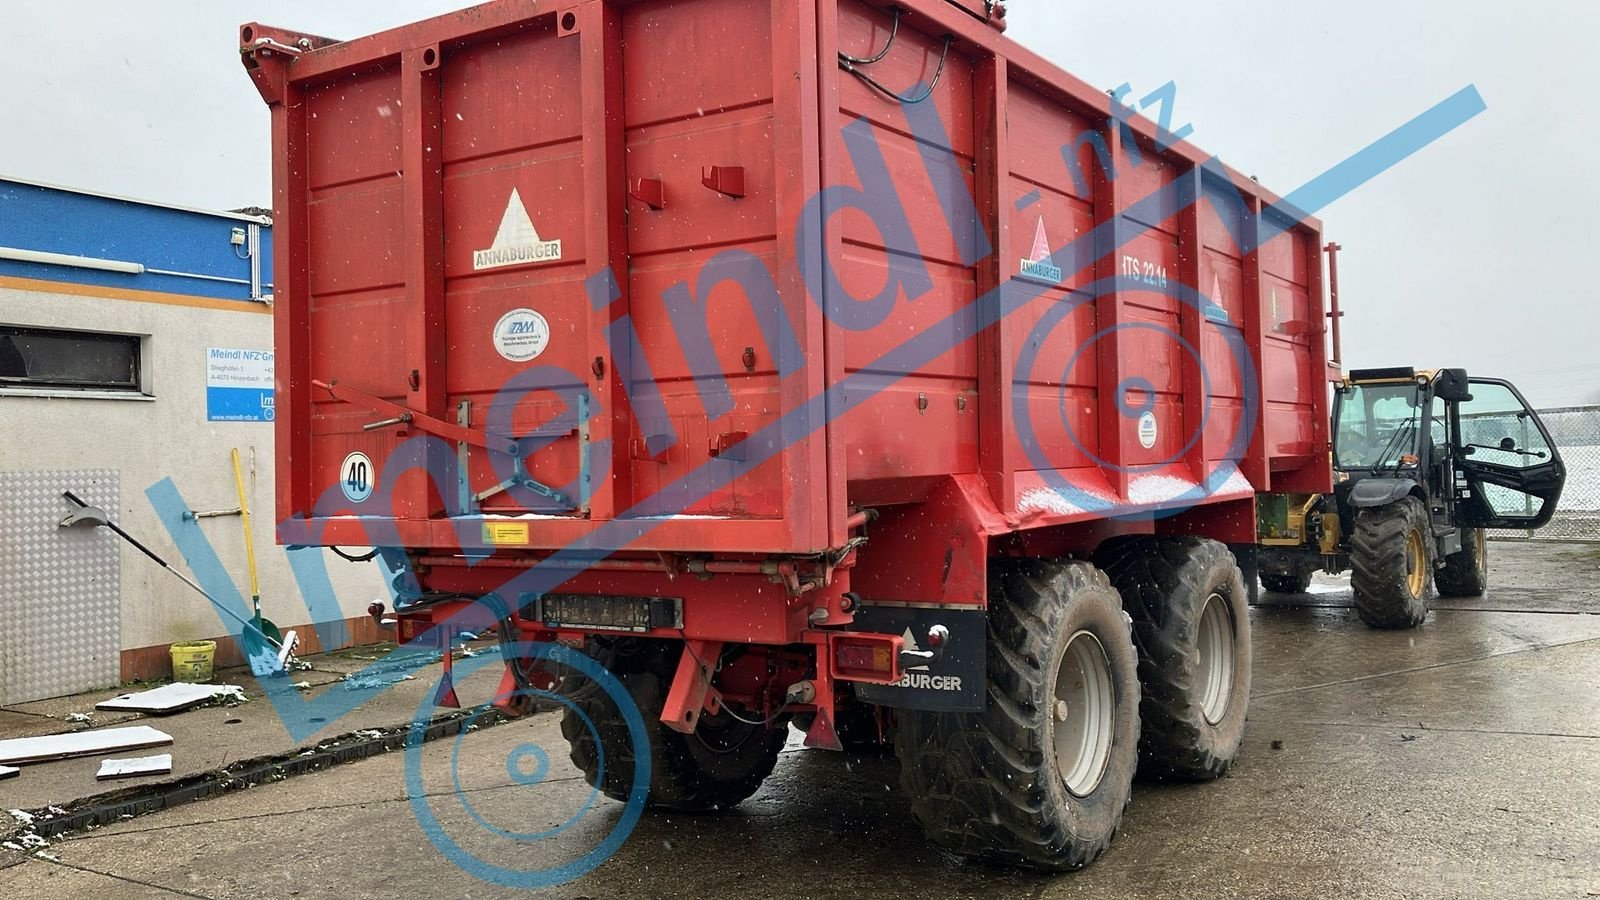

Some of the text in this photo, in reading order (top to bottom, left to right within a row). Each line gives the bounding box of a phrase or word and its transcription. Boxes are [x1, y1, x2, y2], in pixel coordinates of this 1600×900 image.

[476, 243, 559, 266] ANNABURGER
[1021, 260, 1060, 280] ANNABURGER
[1143, 261, 1167, 289] 22.14
[210, 349, 240, 359] Meindl
[348, 461, 367, 492] 40
[872, 673, 962, 691] BURGER
